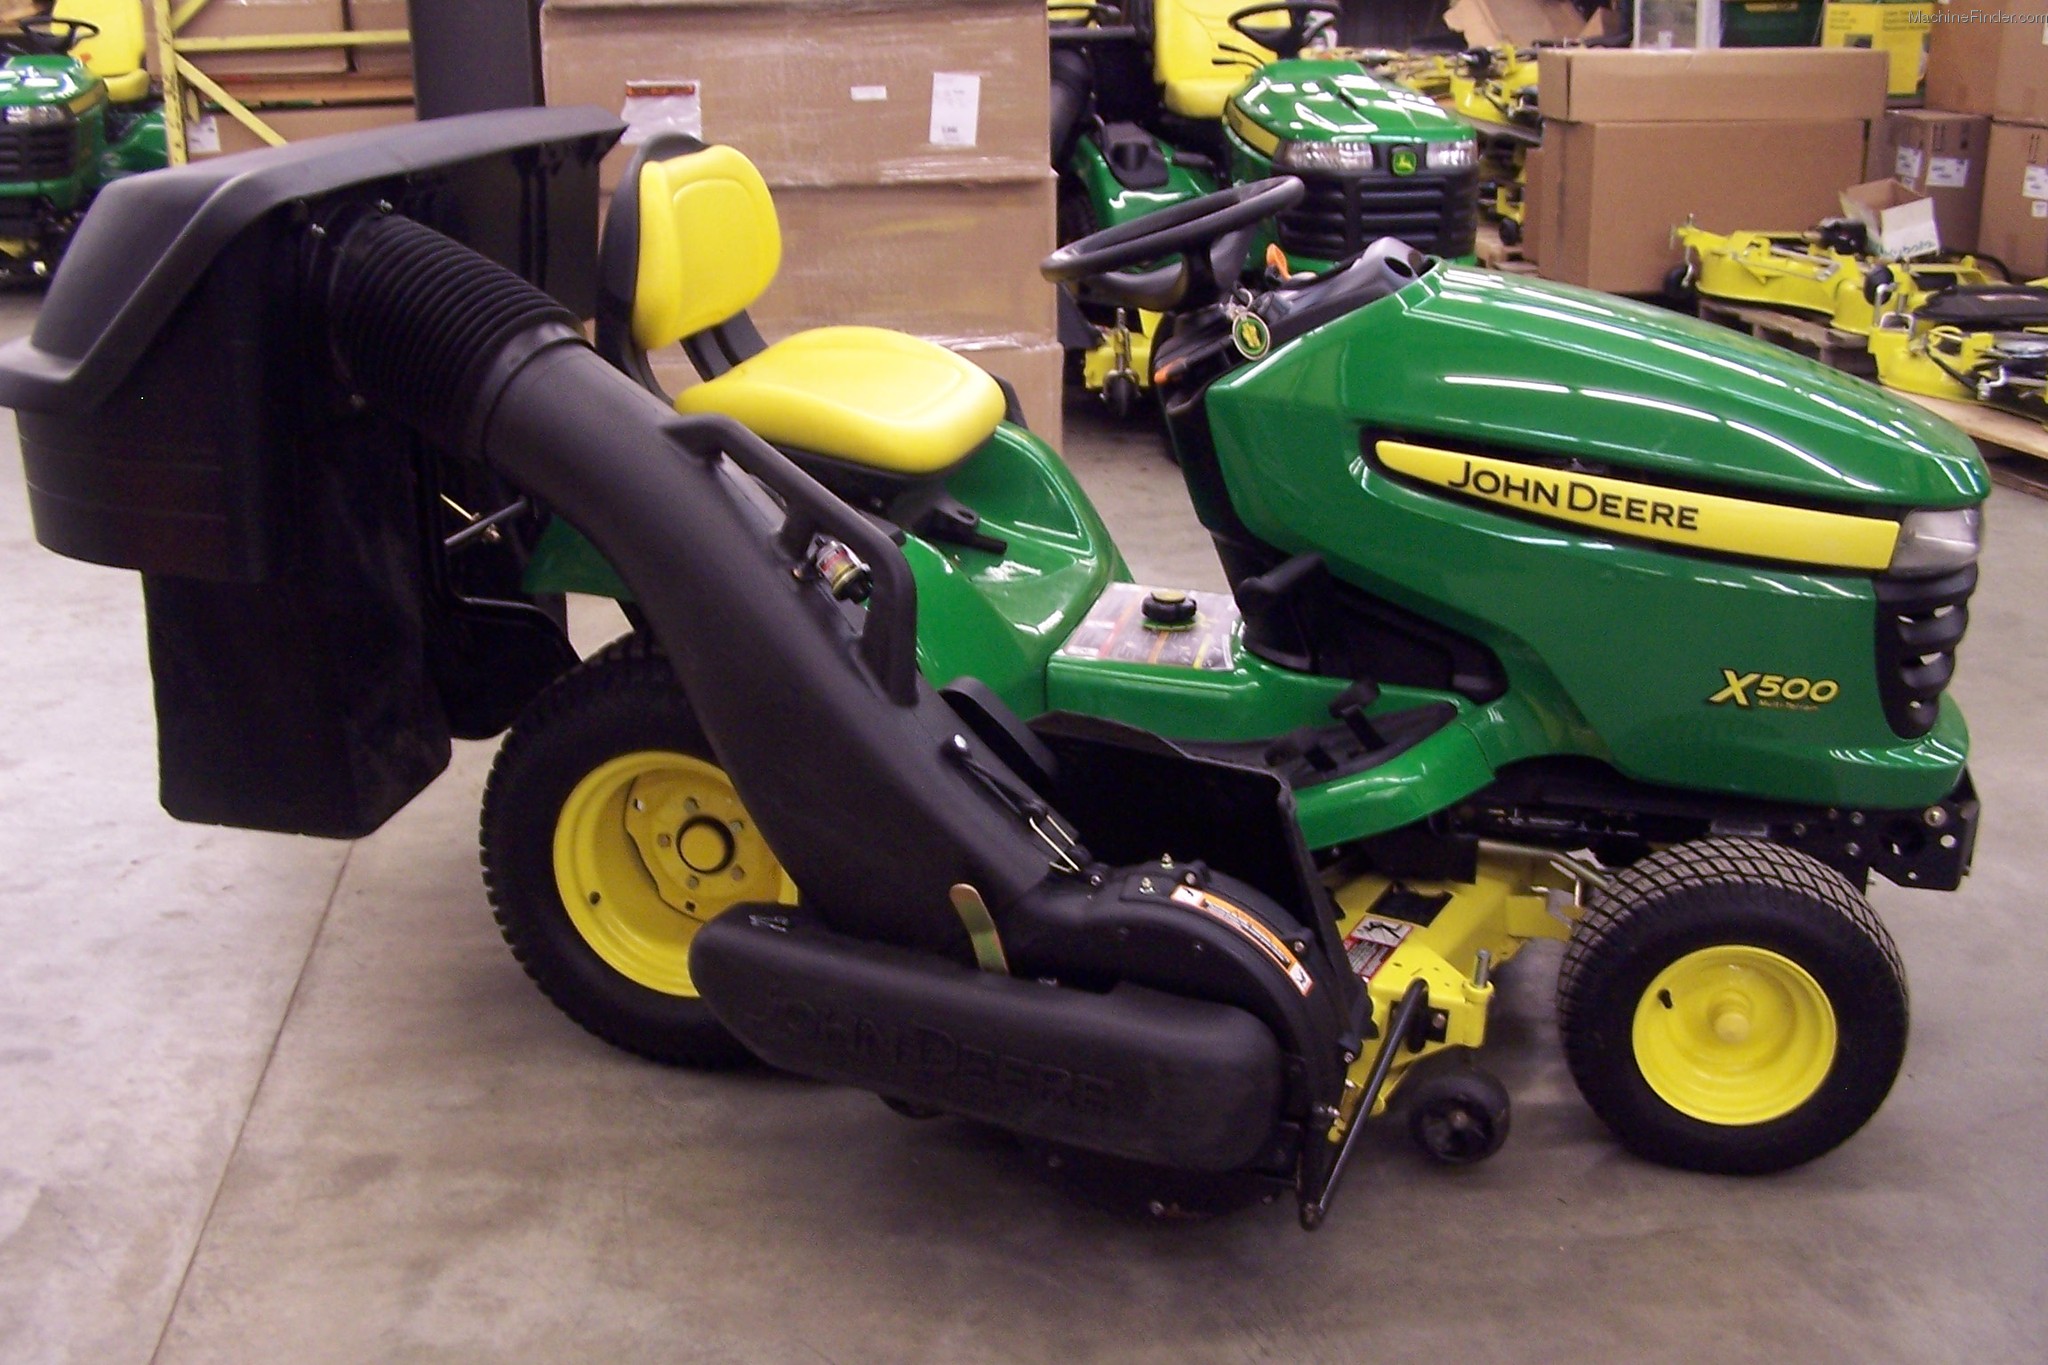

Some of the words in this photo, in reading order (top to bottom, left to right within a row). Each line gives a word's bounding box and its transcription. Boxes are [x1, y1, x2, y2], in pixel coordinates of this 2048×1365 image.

[1448, 460, 1560, 508] JOHN
[1566, 480, 1699, 531] DEERE
[1708, 668, 1840, 706] X500
